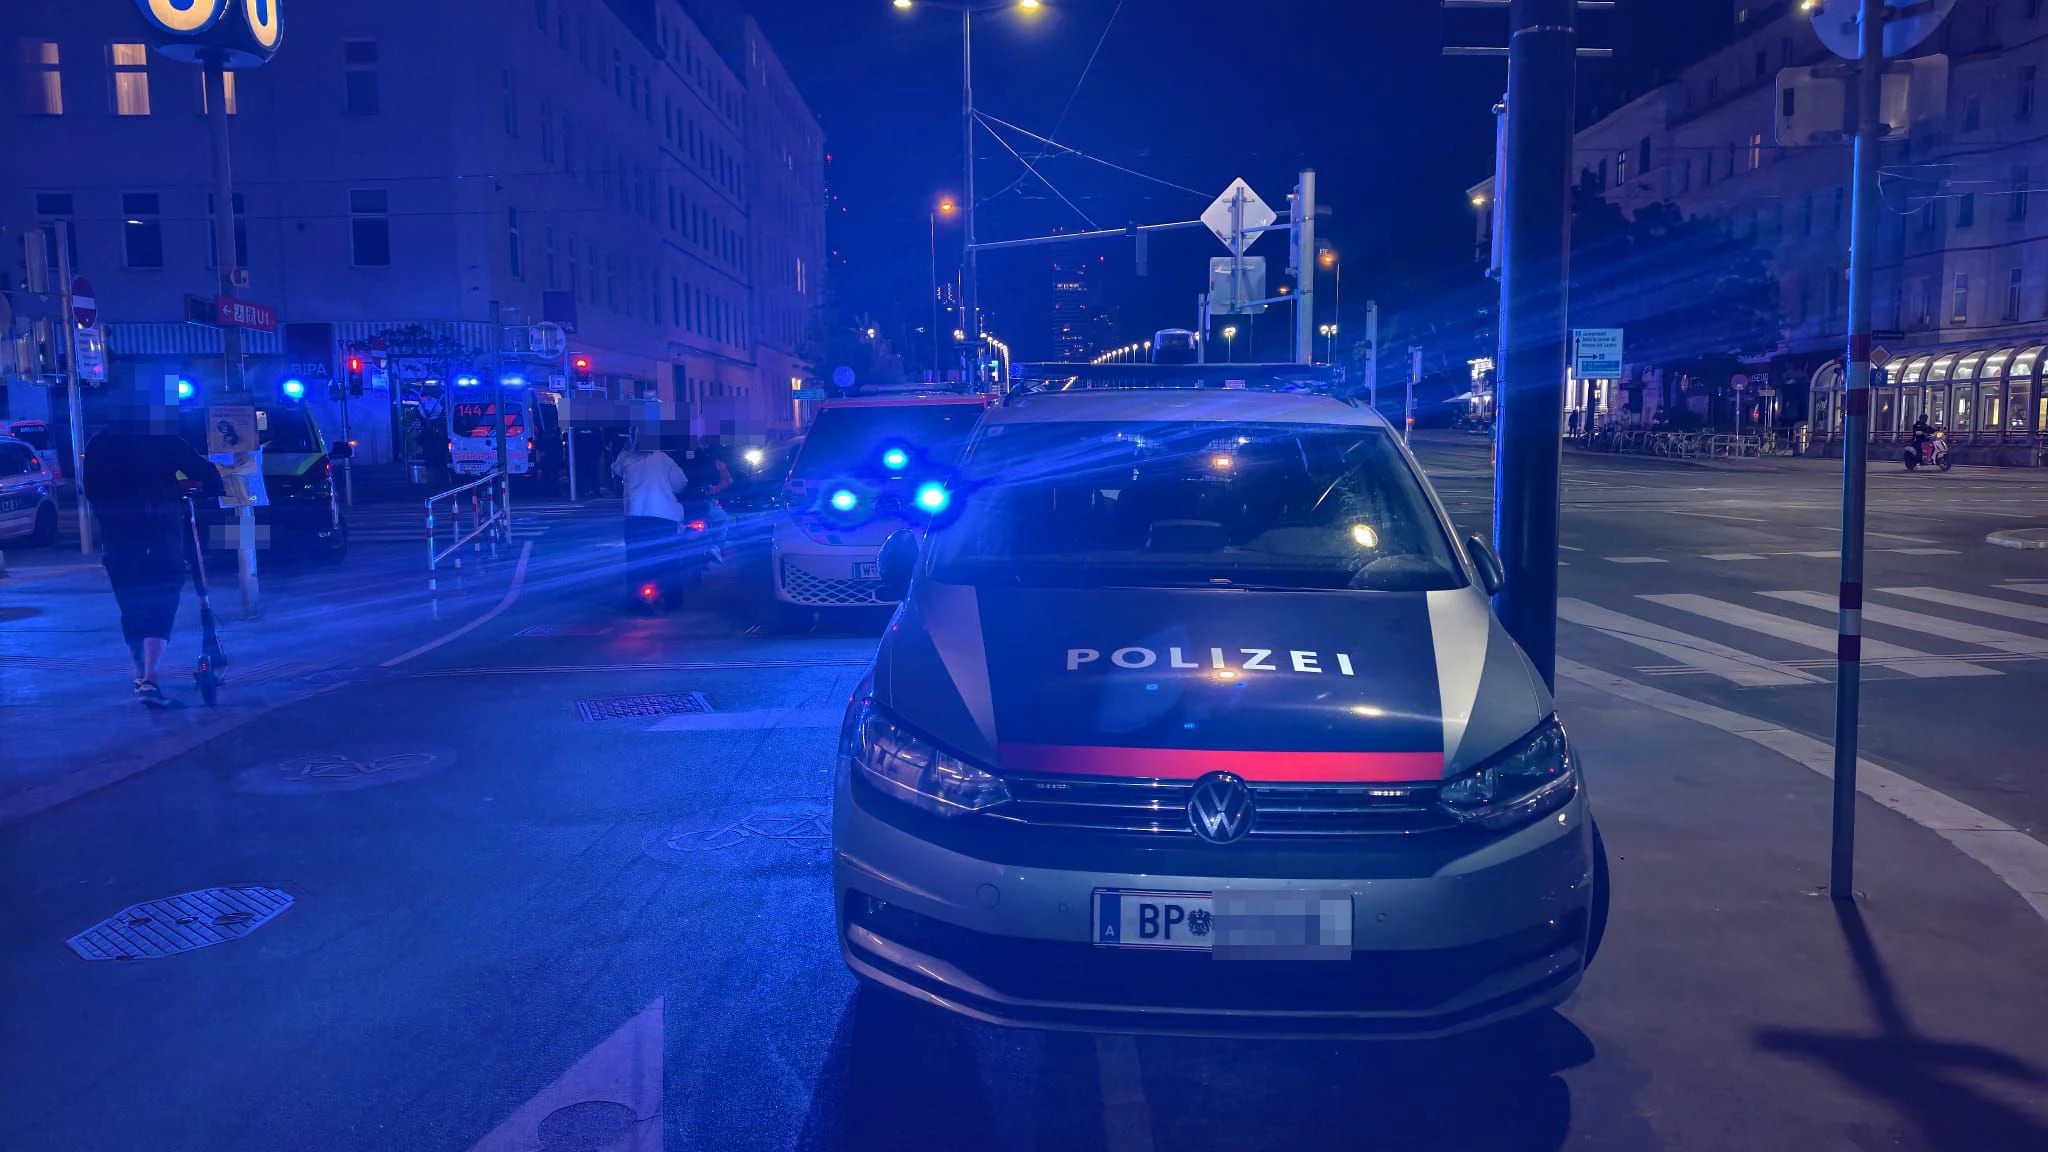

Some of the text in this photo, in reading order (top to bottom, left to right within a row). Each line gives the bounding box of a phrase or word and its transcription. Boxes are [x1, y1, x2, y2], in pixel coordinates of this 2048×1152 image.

[257, 309, 270, 326] U1
[459, 404, 481, 416] 144
[1066, 647, 1355, 676] POLIZEI
[1105, 925, 1115, 937] A
[1138, 903, 1185, 940] BP
